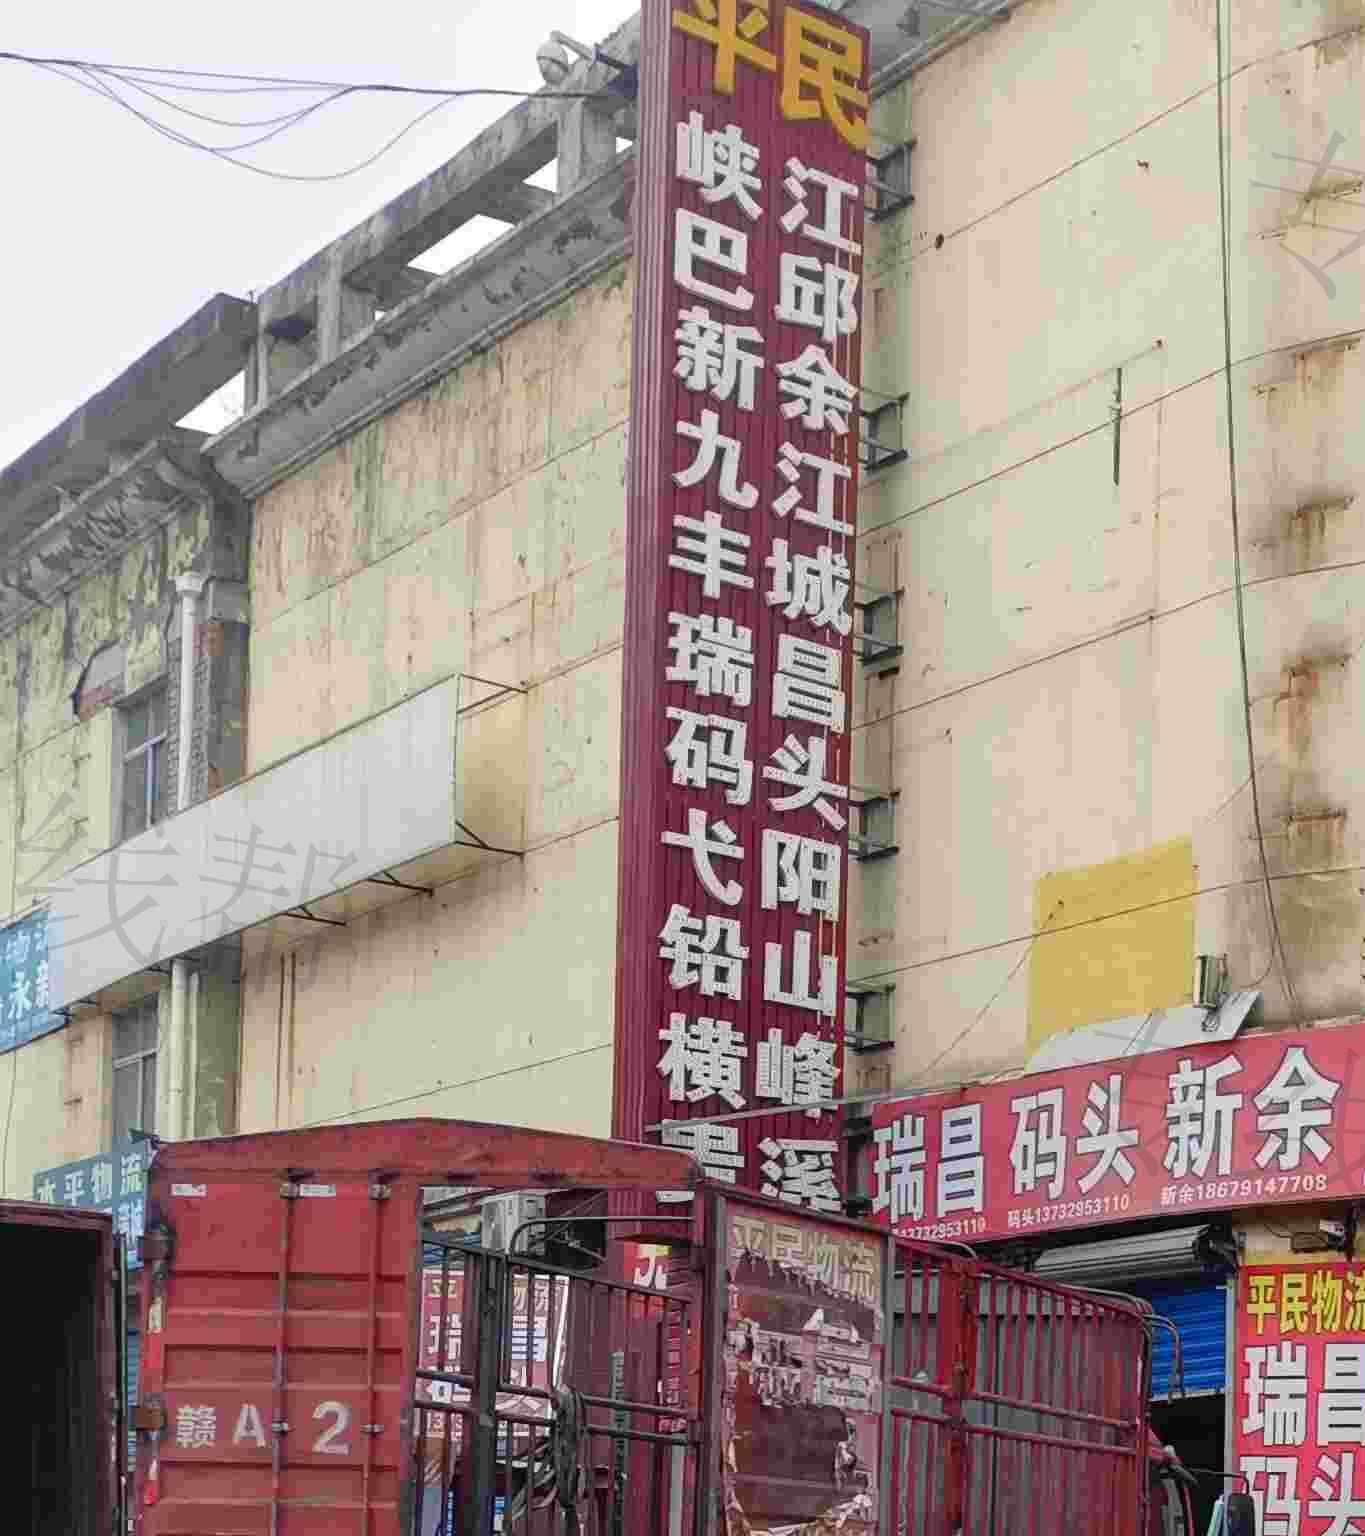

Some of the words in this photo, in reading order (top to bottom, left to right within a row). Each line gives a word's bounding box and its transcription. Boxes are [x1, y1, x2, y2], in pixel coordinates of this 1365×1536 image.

[673, 0, 871, 150] 平民
[871, 1103, 984, 1225] 瑞昌
[1010, 1072, 1139, 1201] 码头
[1164, 1047, 1342, 1179] 新余
